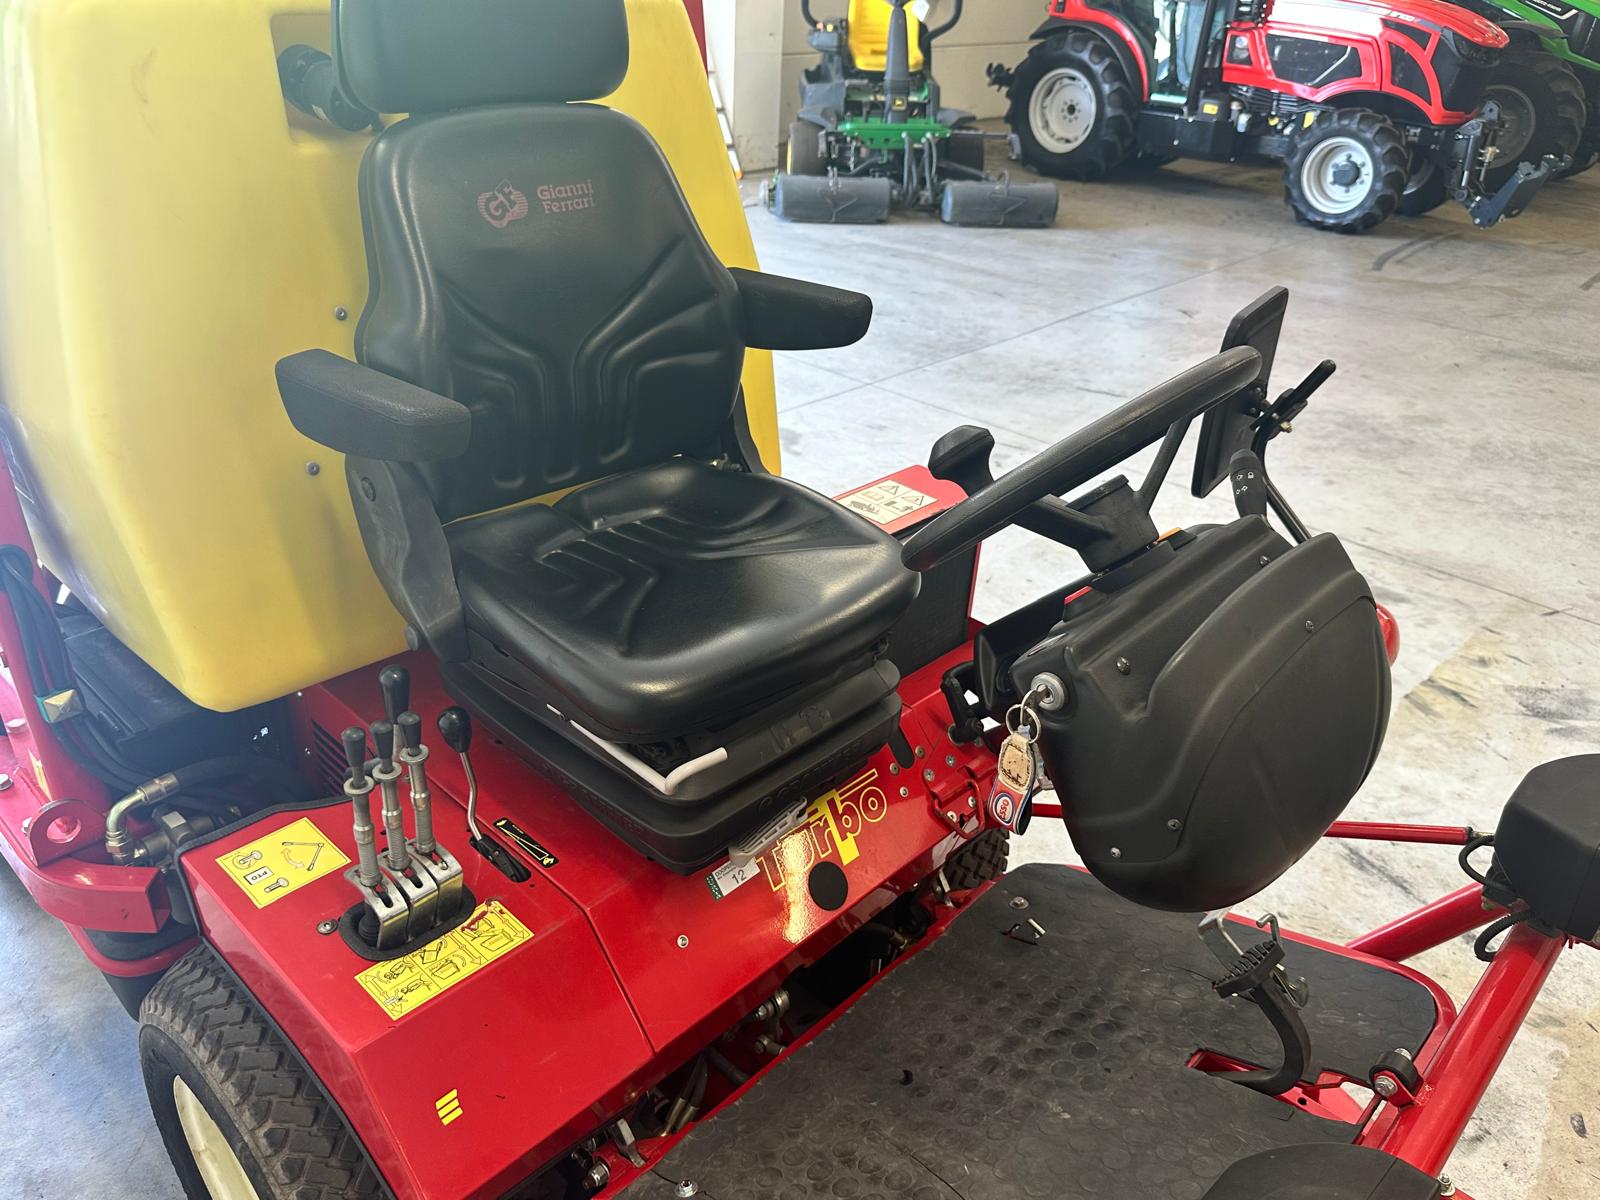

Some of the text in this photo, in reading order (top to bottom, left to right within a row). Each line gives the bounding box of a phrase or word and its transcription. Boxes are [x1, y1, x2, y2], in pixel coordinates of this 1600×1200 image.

[536, 180, 594, 200] Gianni
[541, 194, 595, 214] Ferrari
[251, 870, 268, 881] PTO
[732, 869, 747, 884] 12
